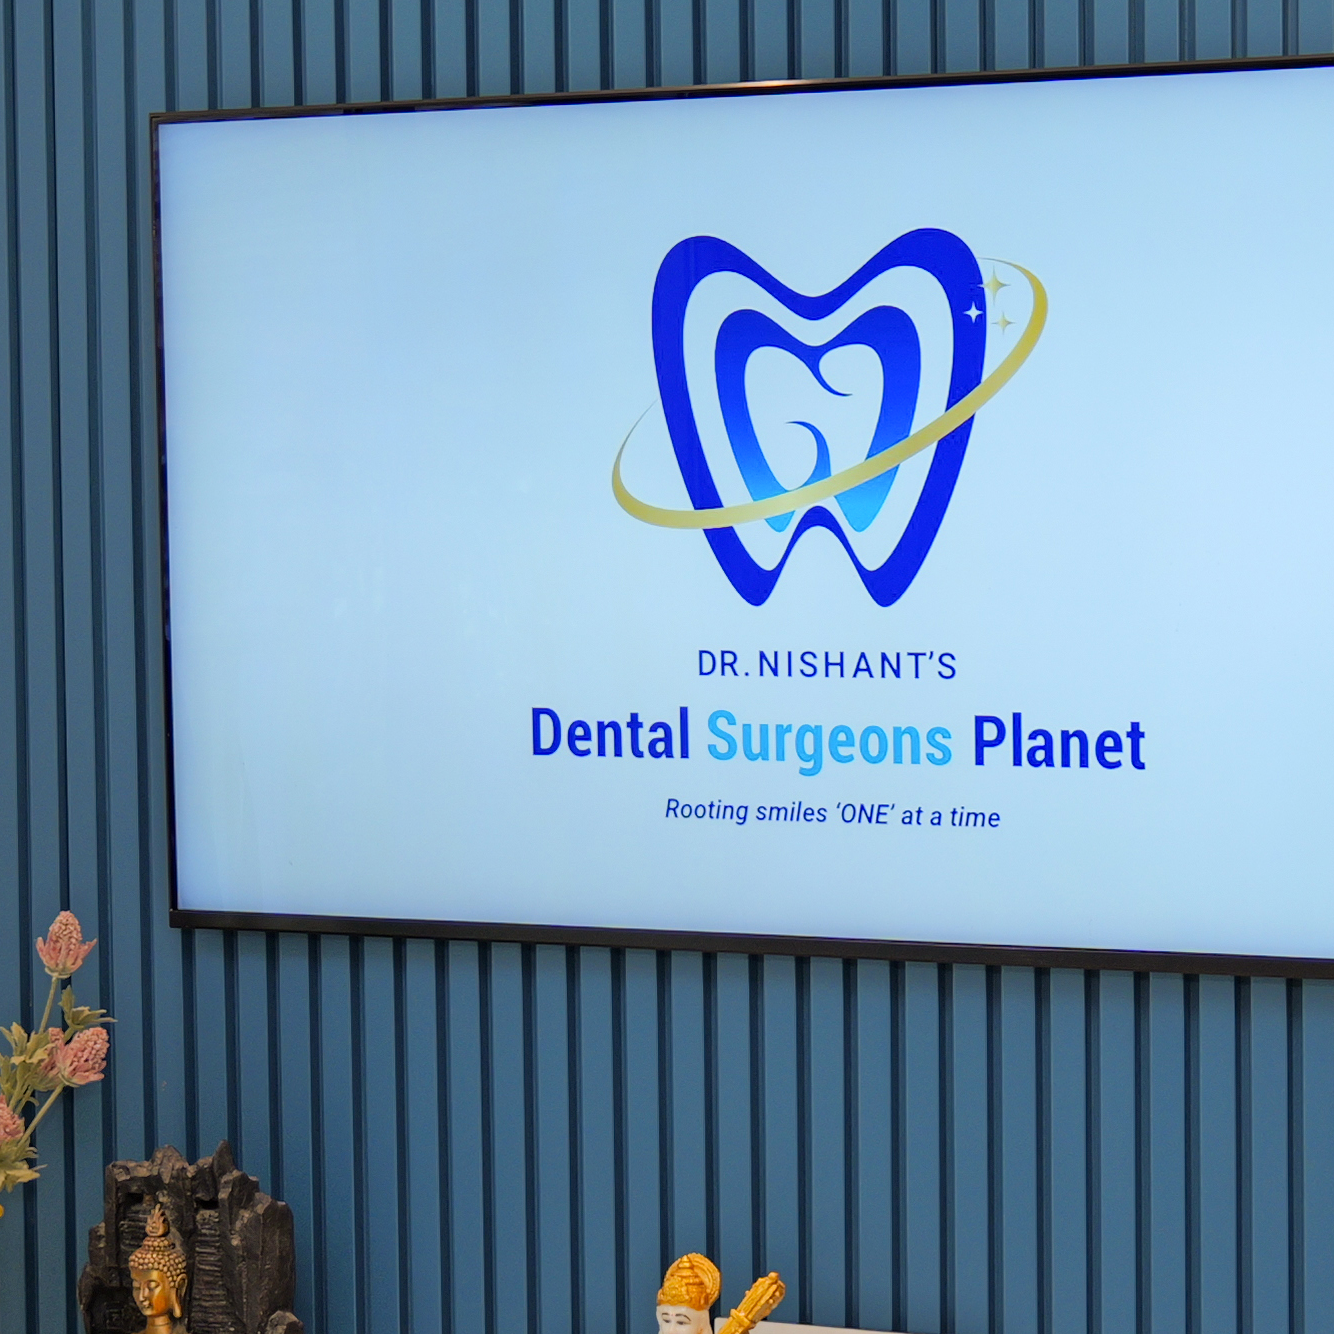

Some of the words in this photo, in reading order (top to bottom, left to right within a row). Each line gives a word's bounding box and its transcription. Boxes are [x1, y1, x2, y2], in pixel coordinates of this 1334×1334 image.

[531, 705, 690, 760] Dental
[707, 709, 953, 778] Surgeons
[974, 711, 1147, 771] Planet
[665, 797, 749, 826] Rooting
[755, 800, 828, 823] smiles
[836, 801, 896, 825] 'ONE'
[901, 806, 924, 826] at
[929, 810, 943, 827] a
[949, 805, 1001, 829] time
